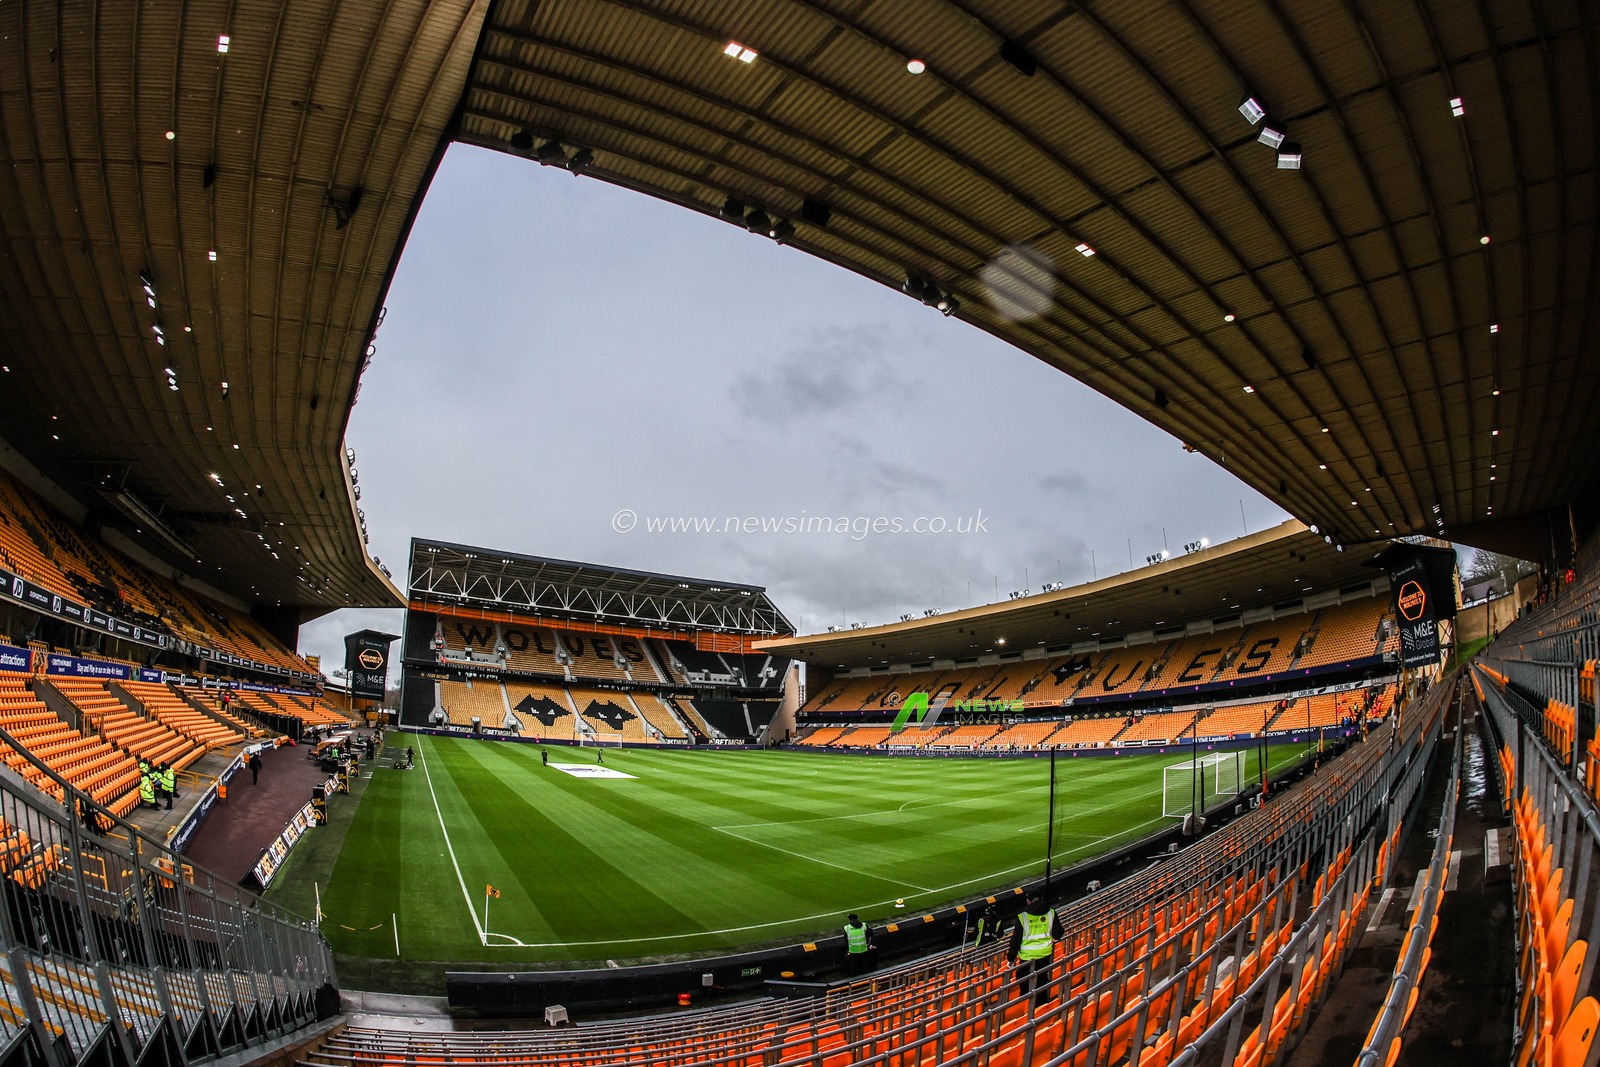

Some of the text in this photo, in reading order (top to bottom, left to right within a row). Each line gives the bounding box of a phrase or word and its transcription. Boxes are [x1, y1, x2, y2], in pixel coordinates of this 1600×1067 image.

[1413, 620, 1434, 639] M&E
[457, 622, 644, 662] WOLVES
[1415, 637, 1436, 650] Global
[367, 674, 384, 684] M&E
[1335, 683, 1351, 691] CARLING
[1298, 689, 1314, 697] CARLING
[486, 728, 511, 736] BETMGM
